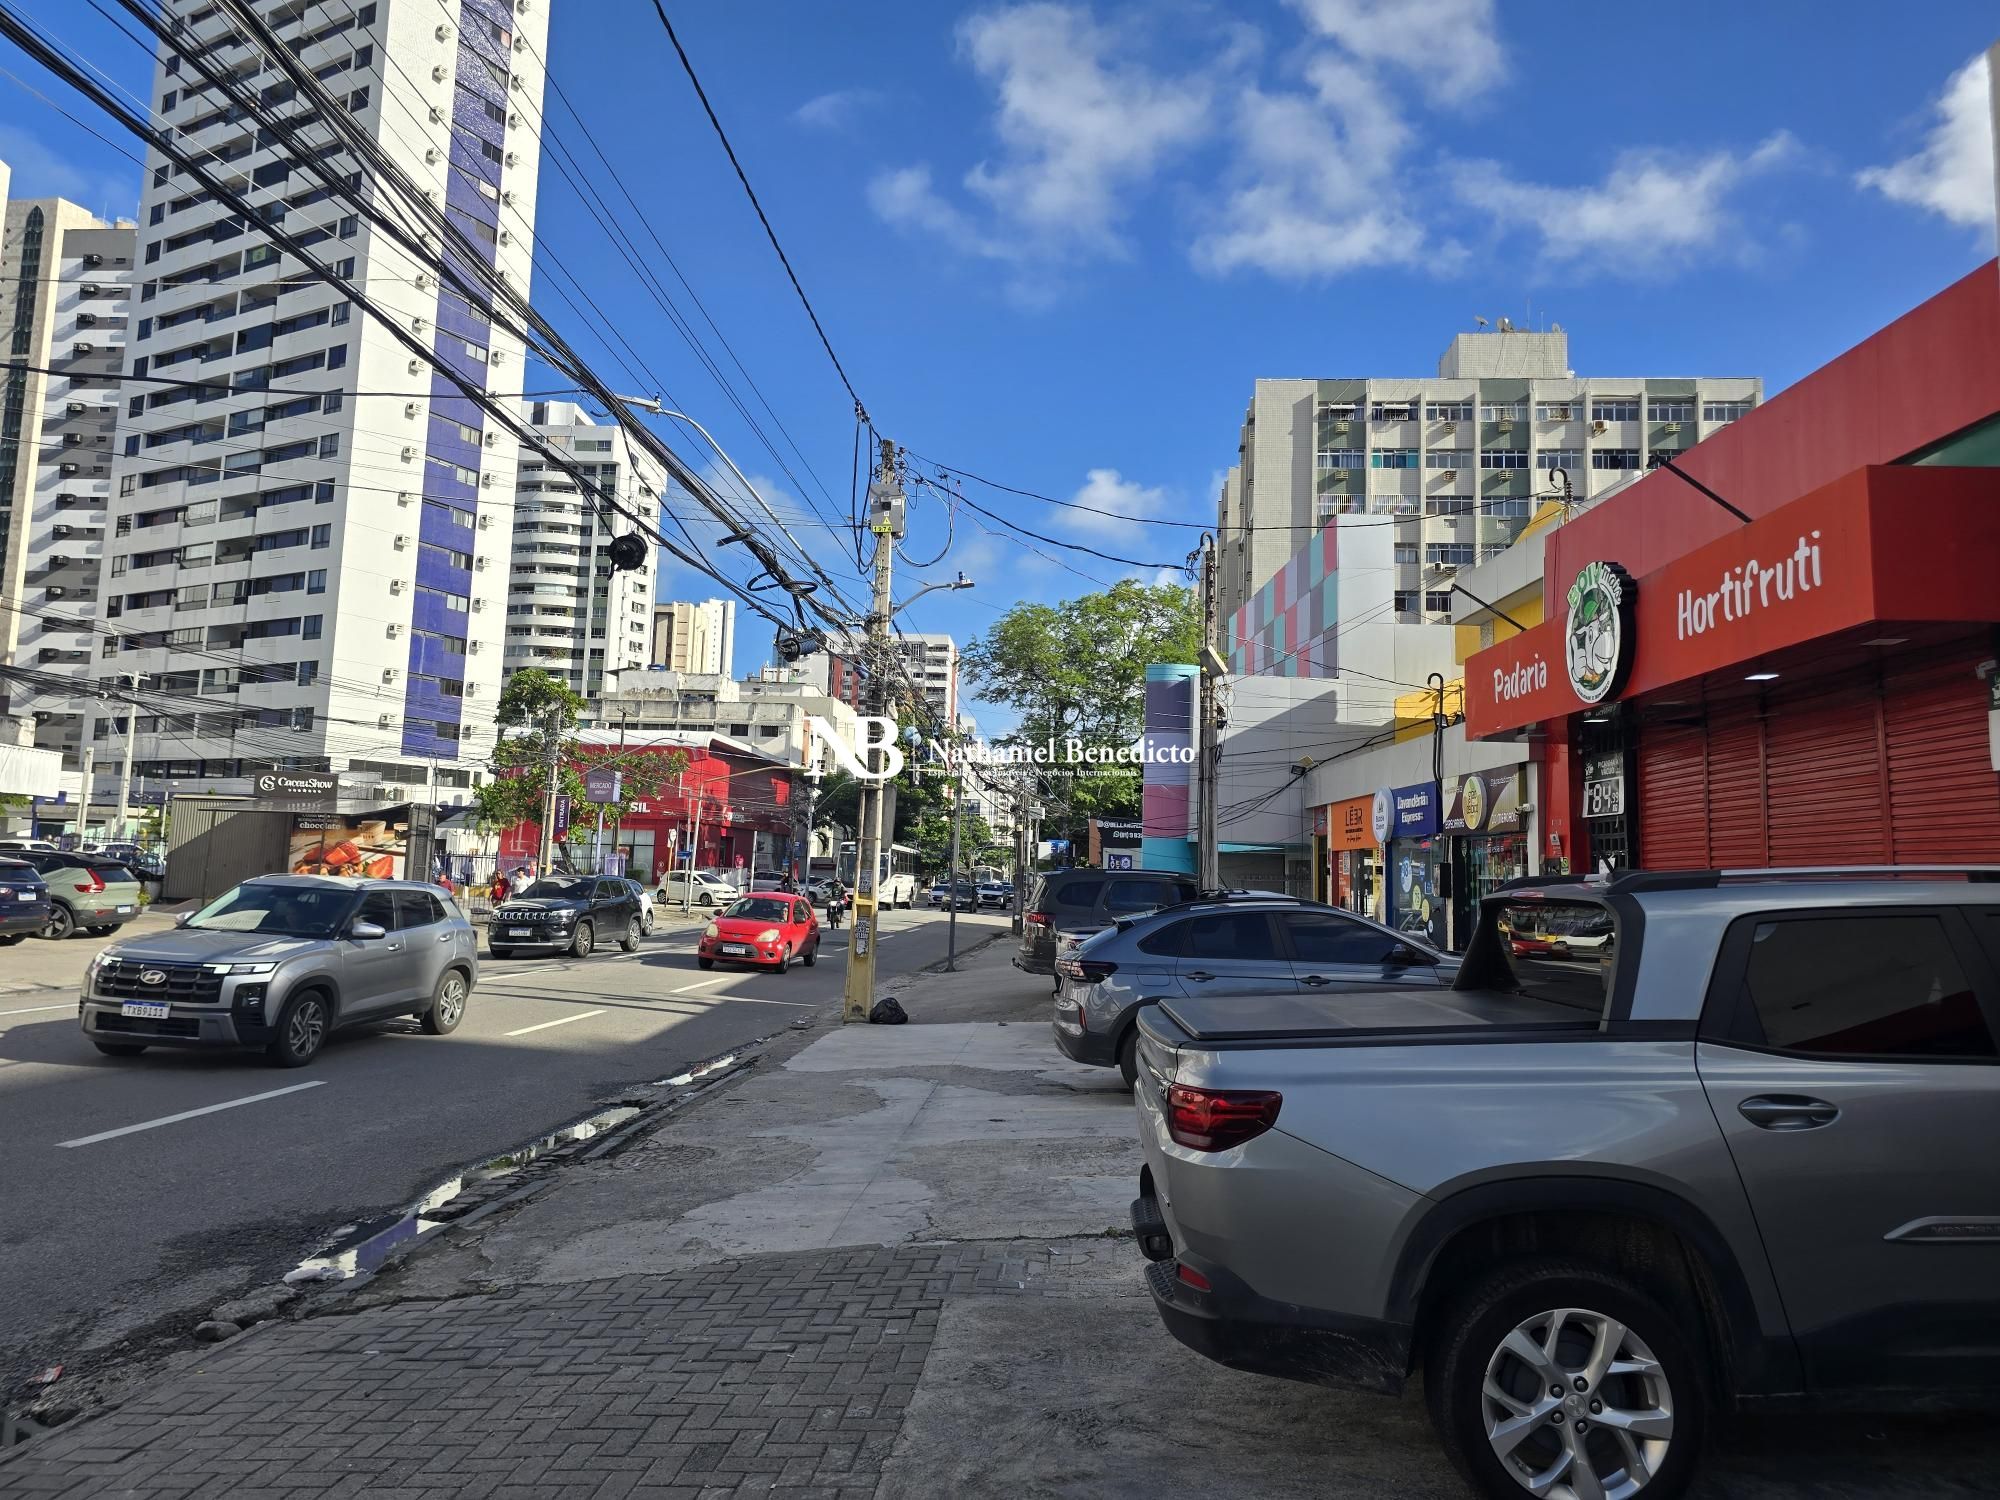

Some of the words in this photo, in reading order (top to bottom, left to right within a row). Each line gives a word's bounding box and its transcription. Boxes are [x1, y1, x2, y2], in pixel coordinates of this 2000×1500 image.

[1676, 530, 1823, 641] Hortifruti
[1492, 652, 1548, 704] Padaria
[558, 799, 566, 828] ENTRADA
